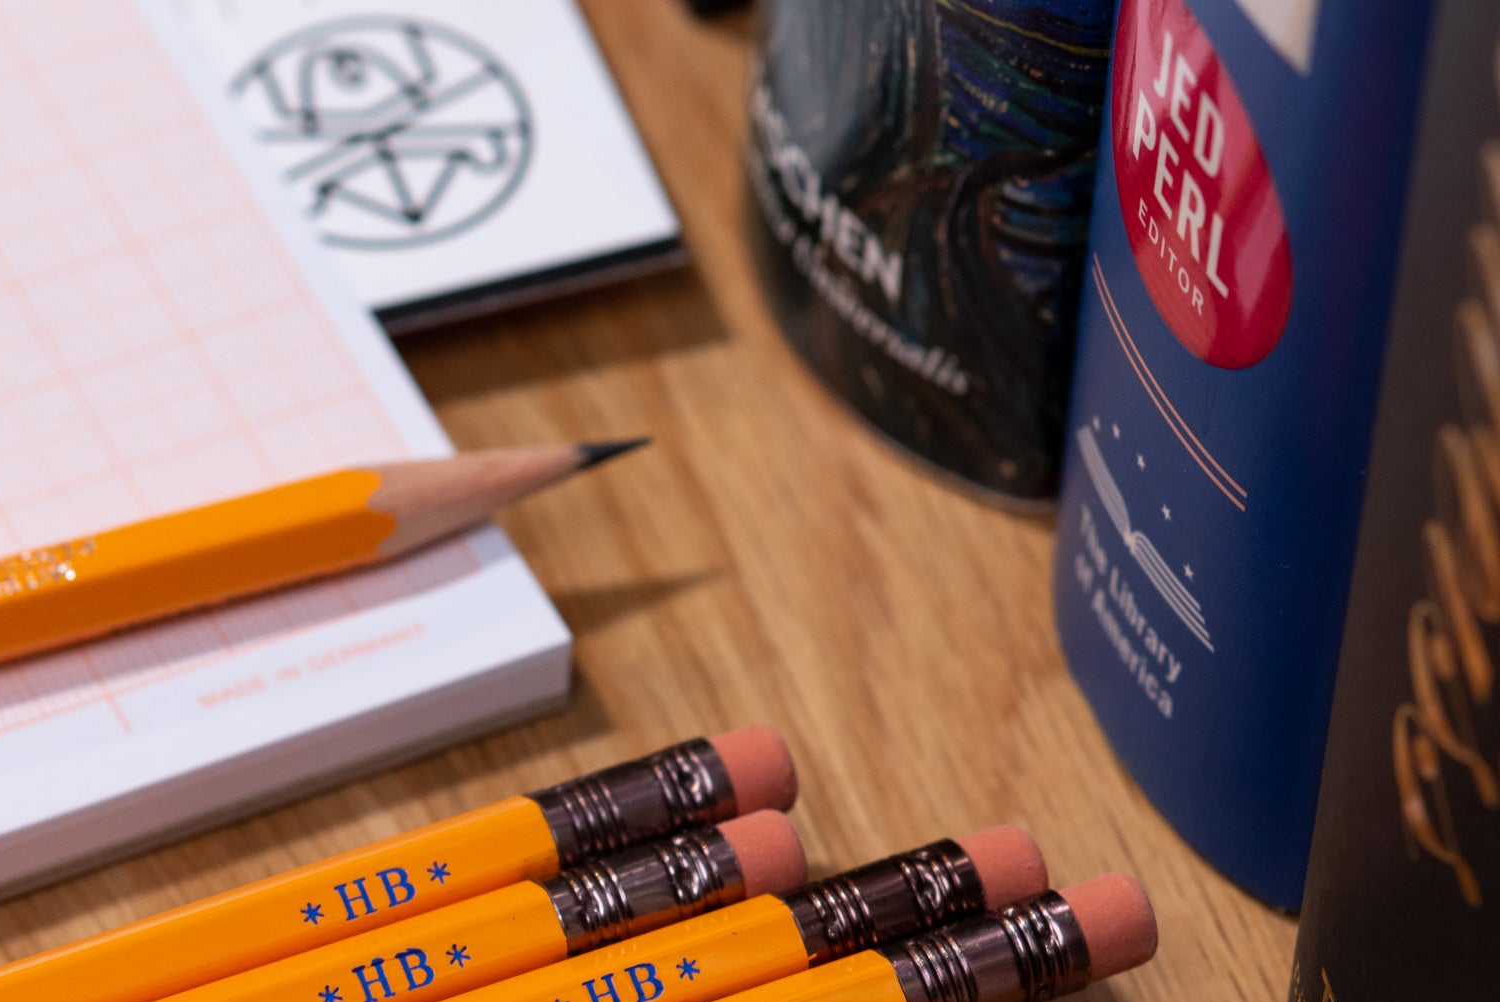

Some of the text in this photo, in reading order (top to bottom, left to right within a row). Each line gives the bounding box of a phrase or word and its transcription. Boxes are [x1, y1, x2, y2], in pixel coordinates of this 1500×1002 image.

[1153, 30, 1225, 178] JED
[1132, 89, 1229, 299] PERL
[1137, 196, 1205, 317] EDITOR
[1109, 565, 1183, 684] Library
